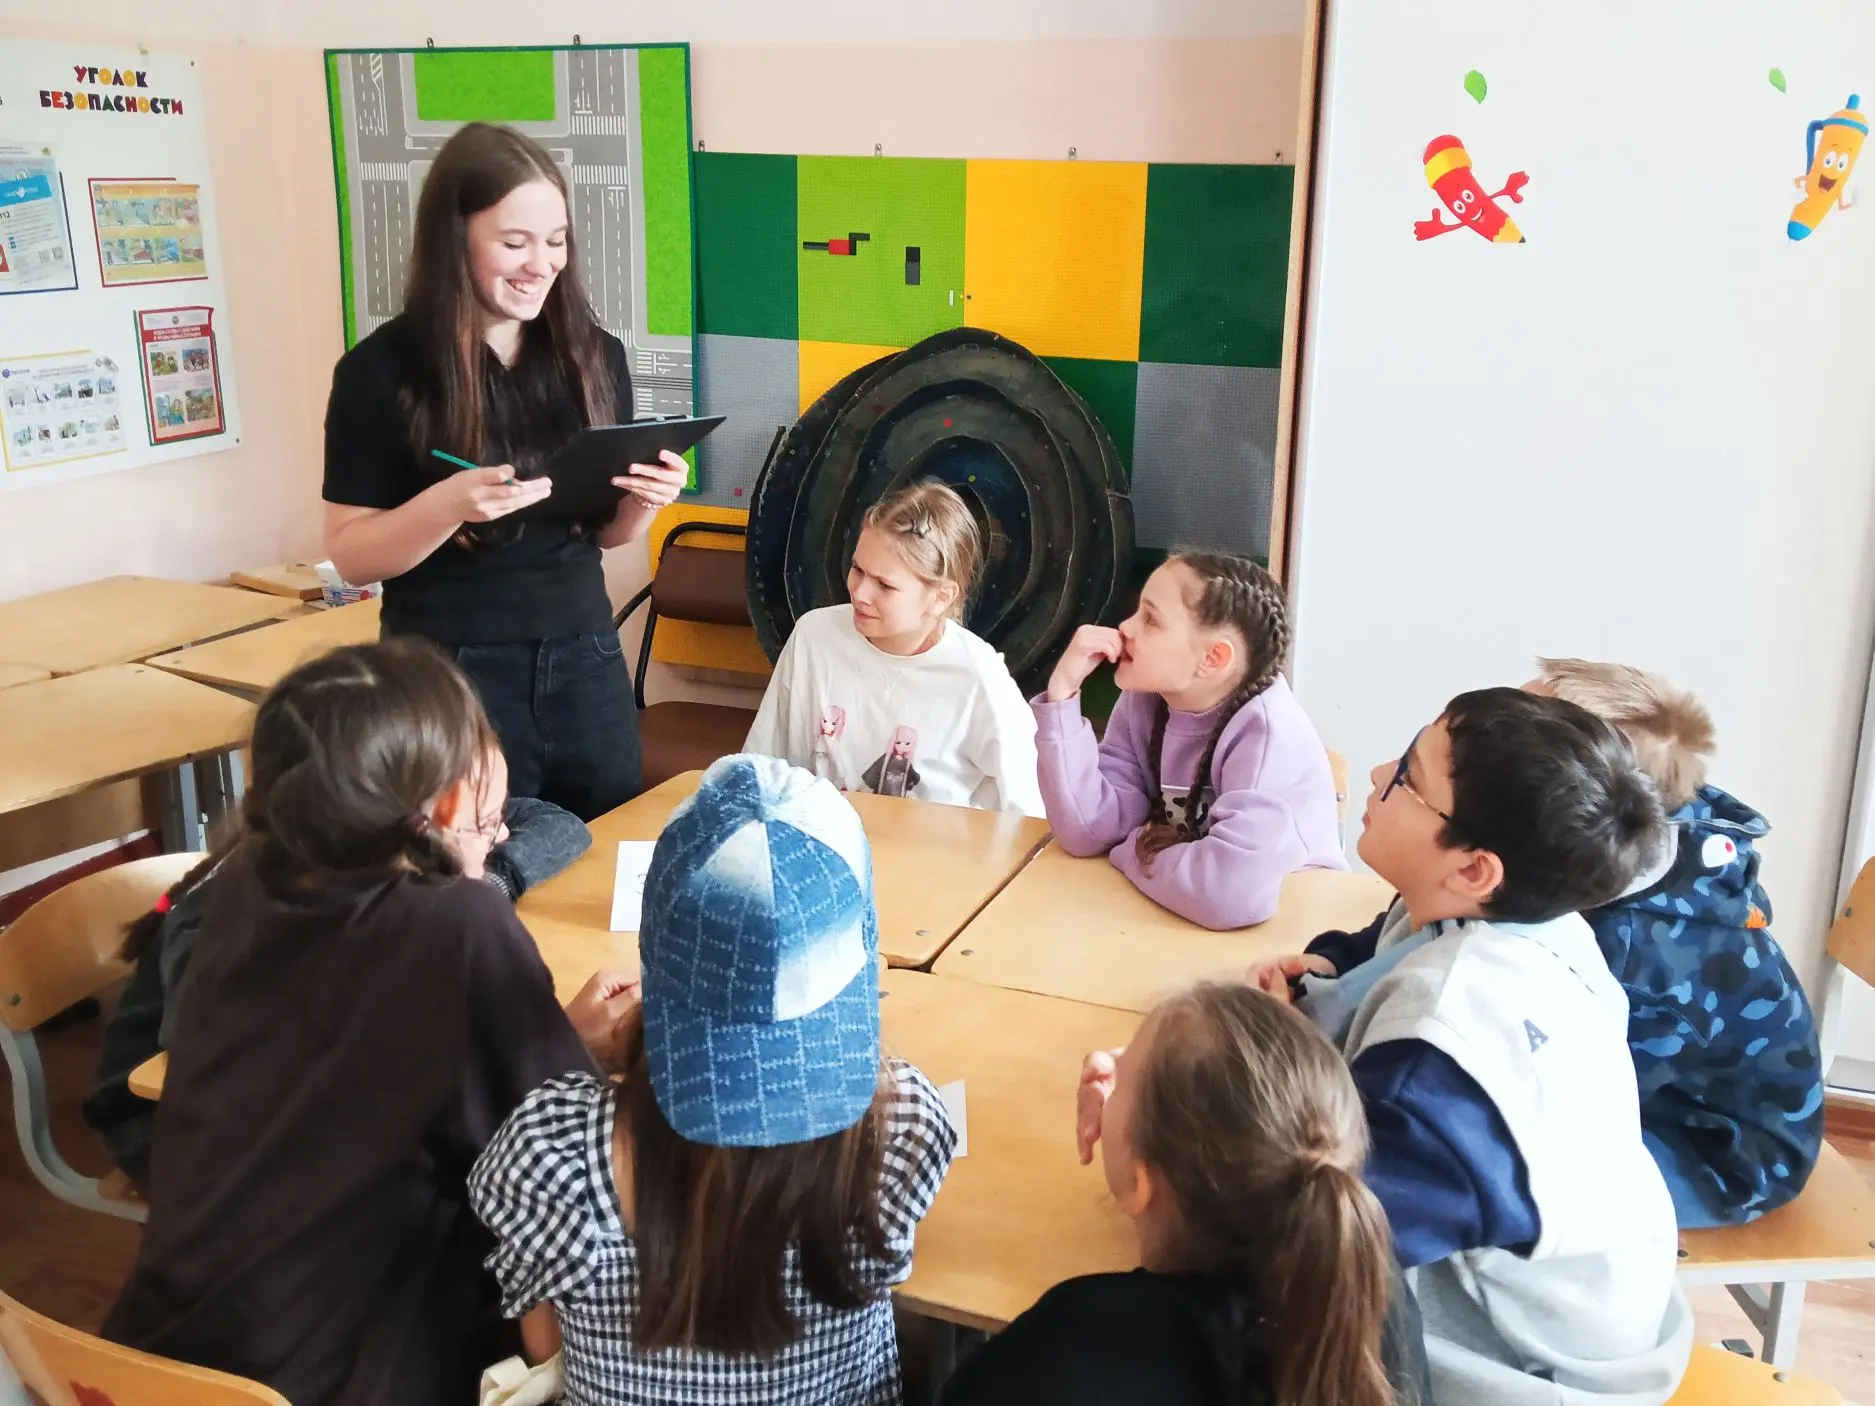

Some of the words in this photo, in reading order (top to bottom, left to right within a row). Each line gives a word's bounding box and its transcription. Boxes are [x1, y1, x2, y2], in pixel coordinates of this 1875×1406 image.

[73, 65, 148, 88] УГОЛОК
[39, 90, 183, 115] БЕЗОПАСНОСТИ
[1523, 1019, 1549, 1053] A
